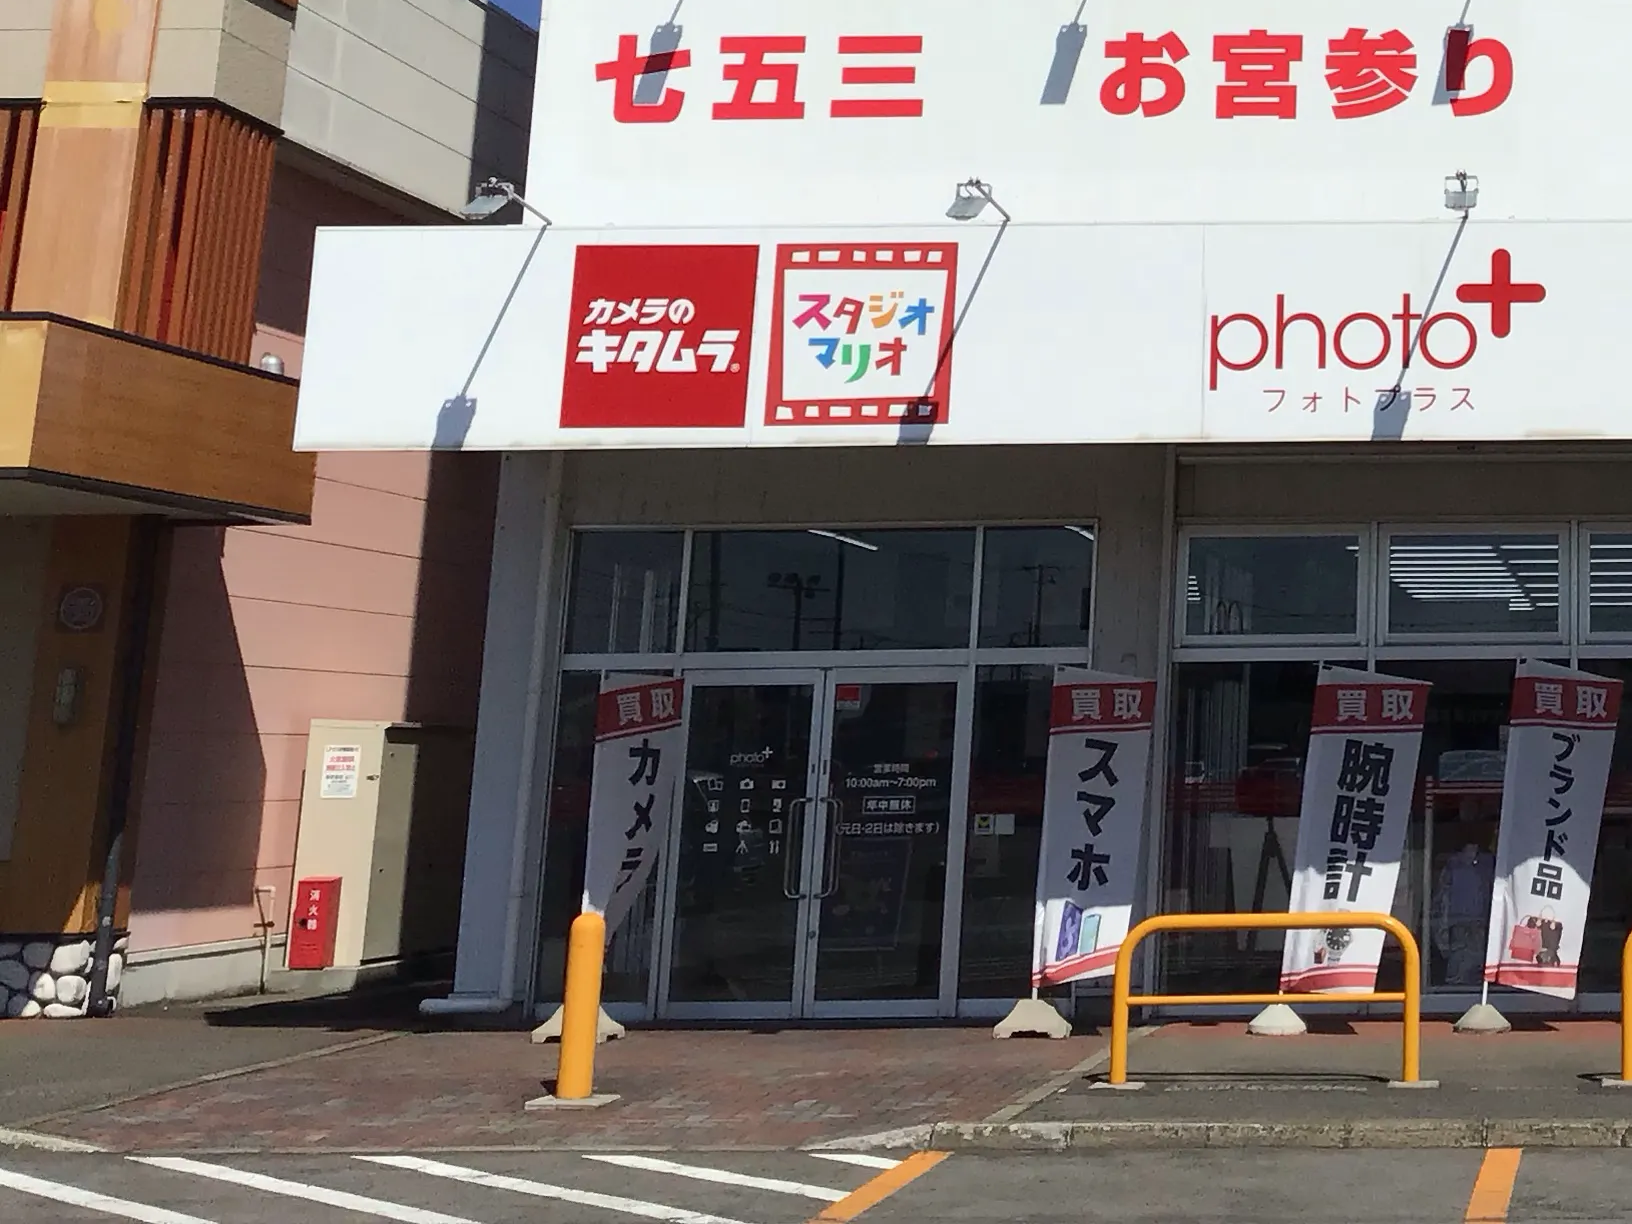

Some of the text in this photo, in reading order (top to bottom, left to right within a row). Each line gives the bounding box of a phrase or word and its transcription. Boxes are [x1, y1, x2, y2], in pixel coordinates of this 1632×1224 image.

[595, 34, 923, 123] 七五三
[1099, 28, 1513, 119] お宮参り
[583, 298, 695, 325] カメラの
[793, 291, 934, 335] スタジオ
[808, 337, 908, 383] マリオ
[1263, 386, 1475, 413] フォトプラス
[617, 687, 675, 726] 買取
[1071, 688, 1143, 721] 買取
[1335, 687, 1414, 721] 買取
[1533, 682, 1608, 719] 買取
[615, 738, 661, 893] カメラ
[866, 799, 913, 811] 年中無休
[1066, 738, 1120, 891] スマホ
[1322, 739, 1395, 903] 腕時計
[1530, 731, 1582, 902] ブランド品
